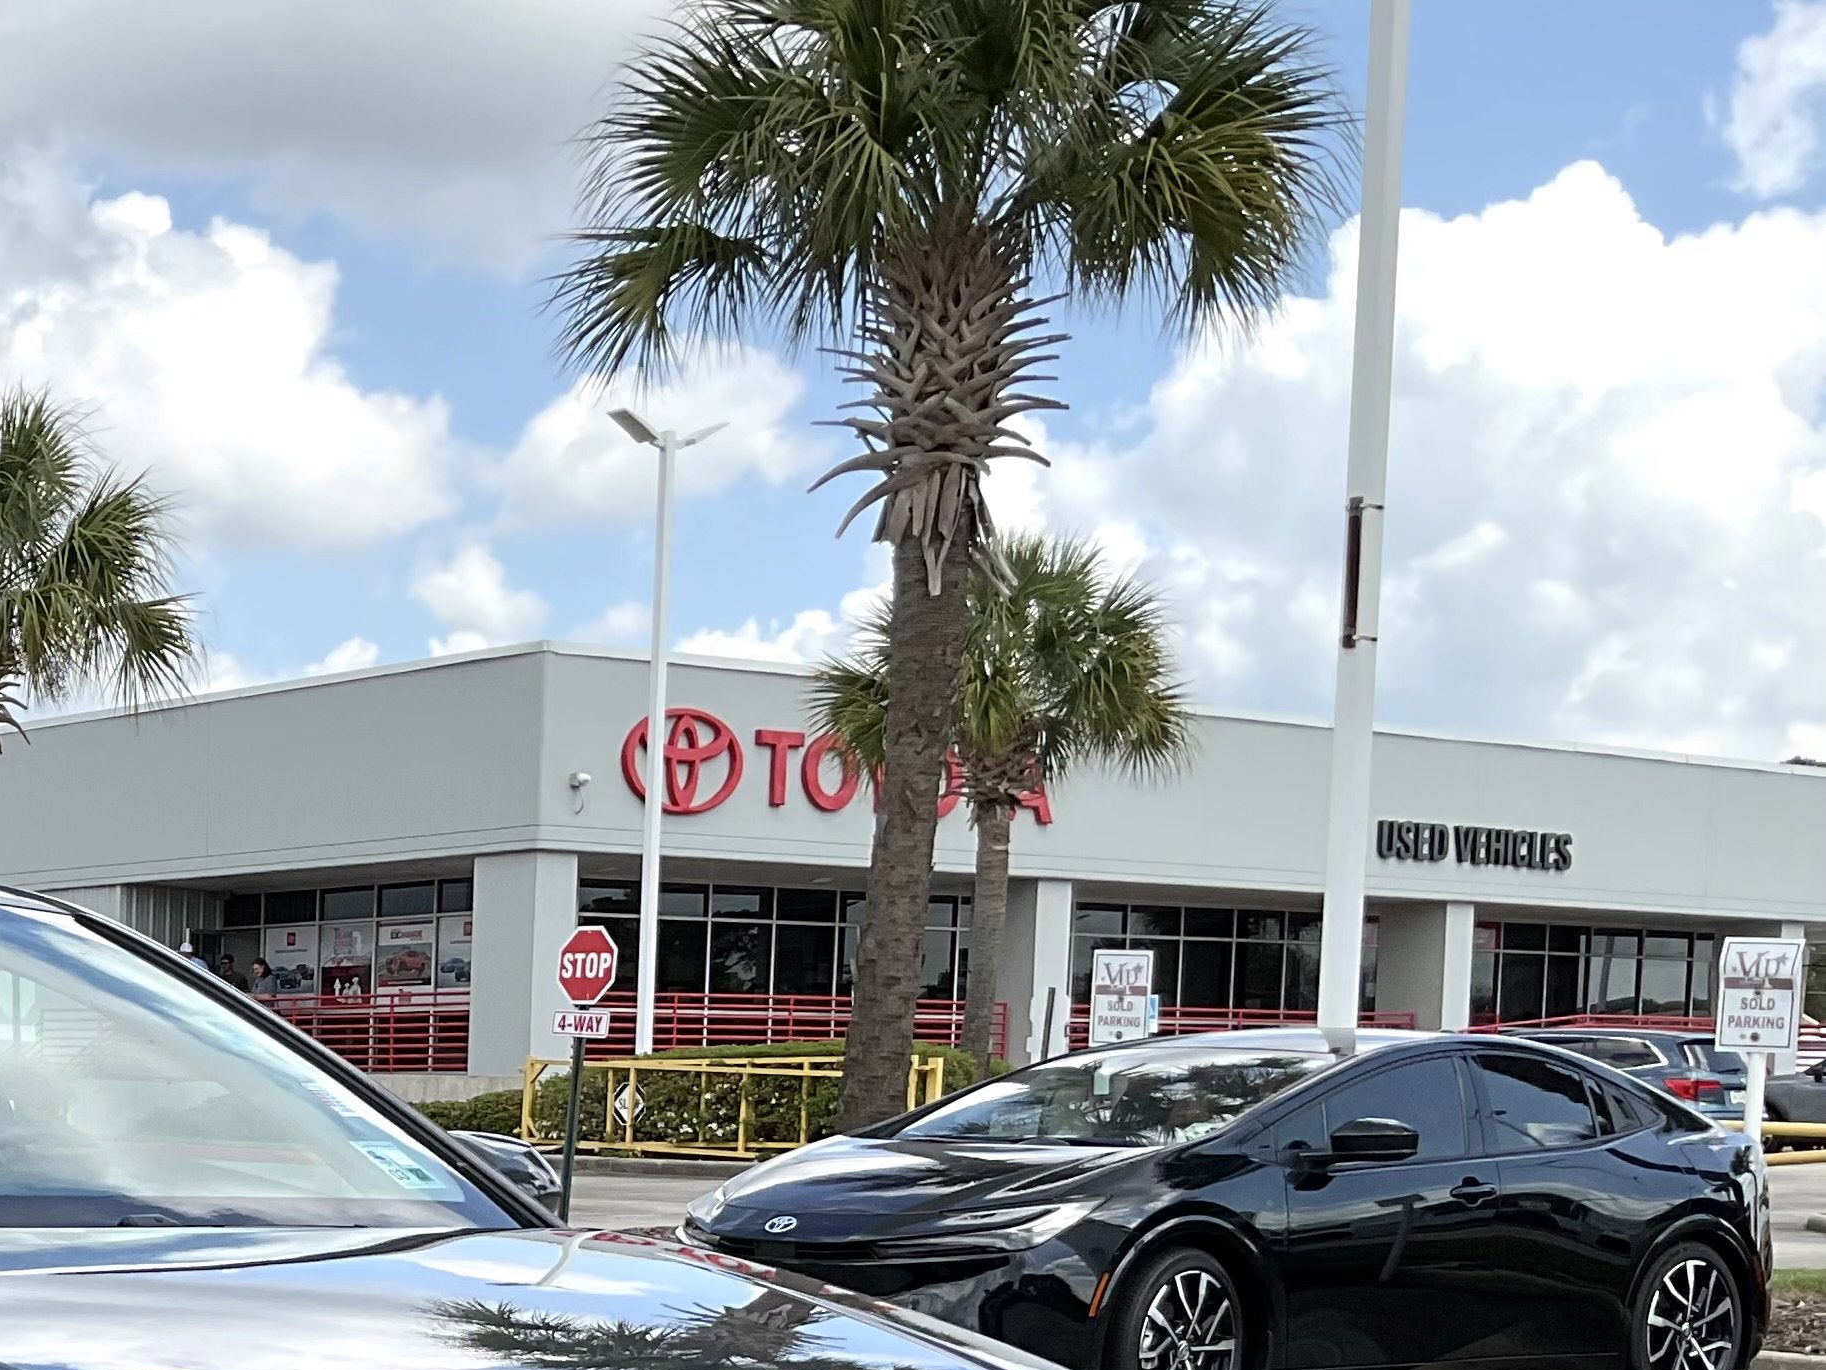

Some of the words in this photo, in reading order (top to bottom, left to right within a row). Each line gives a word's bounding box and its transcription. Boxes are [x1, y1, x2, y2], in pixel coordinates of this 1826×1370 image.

[1376, 819, 1450, 862] USED
[1453, 825, 1573, 871] VEHICLES
[561, 952, 612, 979] STOP
[1106, 1000, 1134, 1012] SOLD
[1740, 997, 1776, 1011] SOLD
[558, 1014, 603, 1033] 4-WAY
[1097, 1015, 1141, 1028] PARKING
[1727, 1015, 1785, 1030] PARKING
